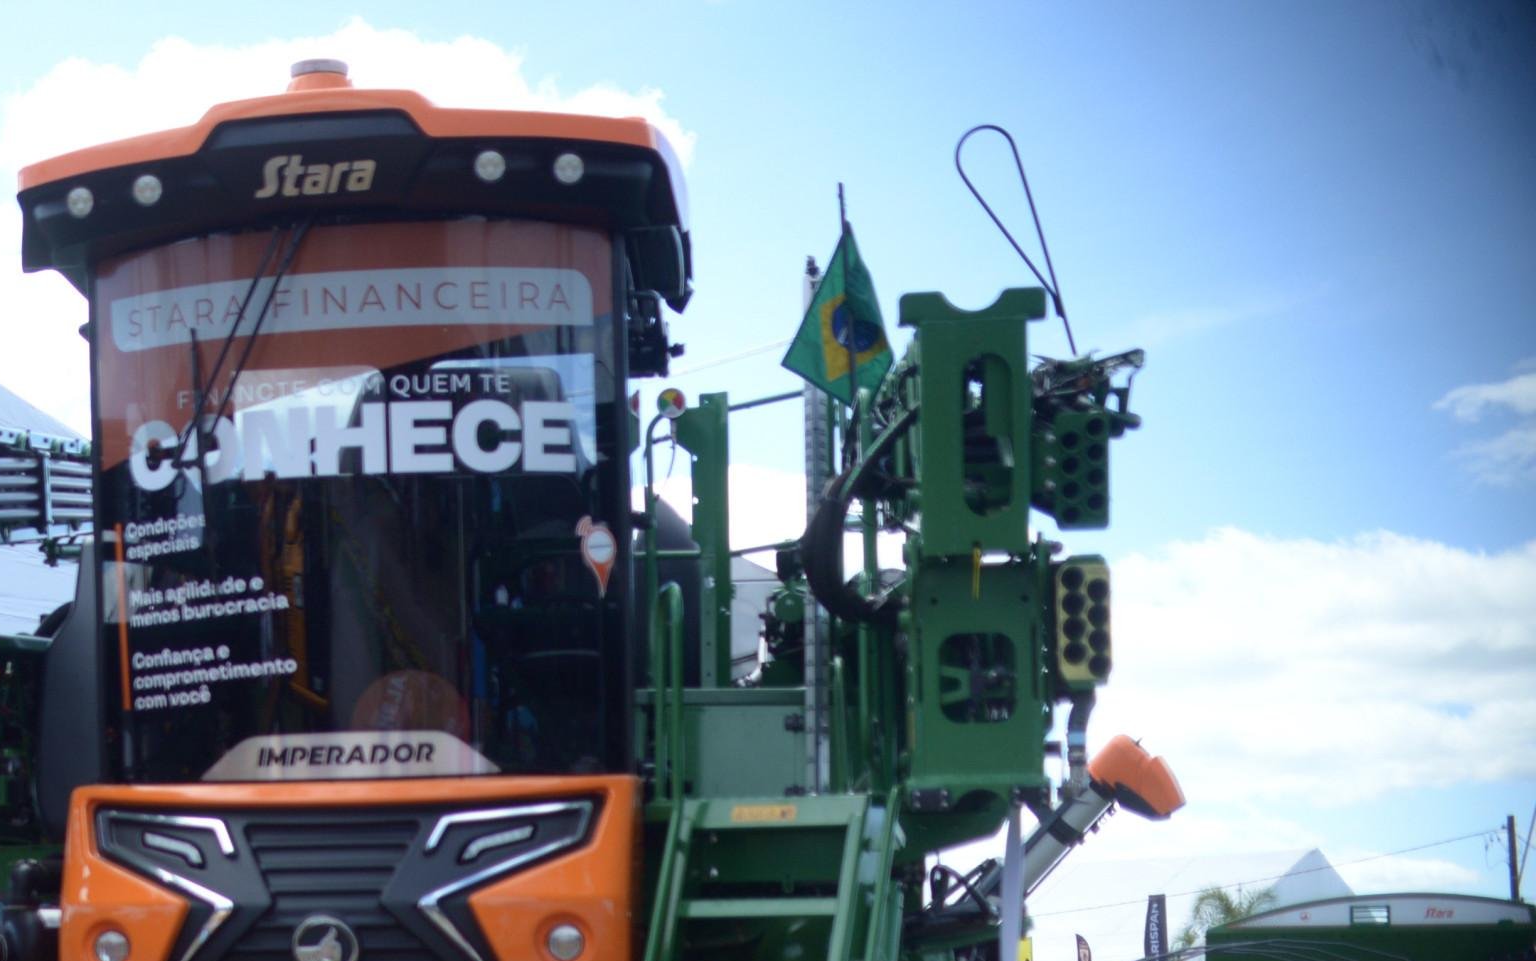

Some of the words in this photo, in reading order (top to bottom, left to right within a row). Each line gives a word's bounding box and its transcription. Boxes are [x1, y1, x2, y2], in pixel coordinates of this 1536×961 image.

[254, 153, 377, 200] Stara
[126, 295, 246, 338] STARA
[271, 280, 572, 318] FINANCEIRA
[390, 373, 471, 398] QUEM
[479, 372, 511, 395] TE
[129, 399, 578, 492] CONHECE
[125, 514, 206, 538] Condições
[126, 535, 201, 561] especiais
[130, 586, 164, 607] Mais
[249, 576, 264, 591] e
[130, 612, 181, 628] menos
[182, 591, 290, 621] burocracia
[132, 647, 214, 669] Confiança
[216, 645, 231, 660] e
[133, 658, 298, 690] comprometimento
[134, 695, 168, 711] com
[168, 684, 212, 706] você
[257, 742, 437, 769] IMPERADOR
